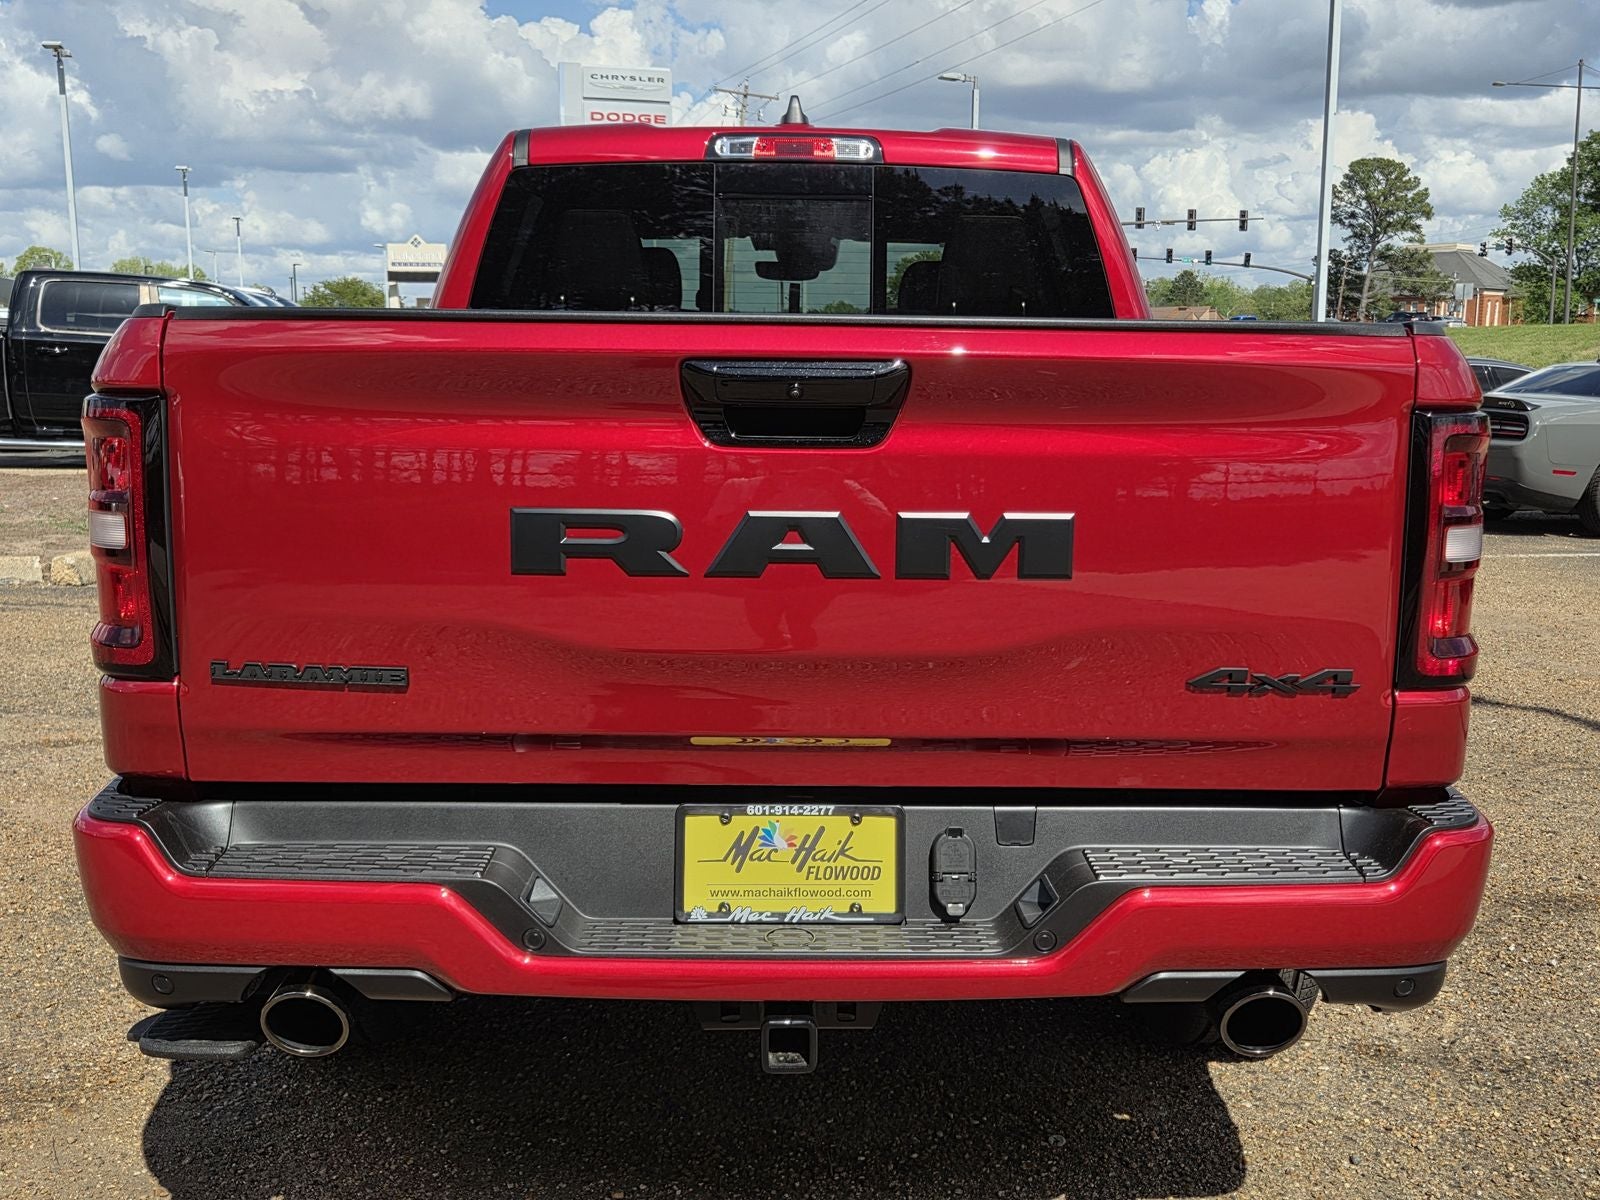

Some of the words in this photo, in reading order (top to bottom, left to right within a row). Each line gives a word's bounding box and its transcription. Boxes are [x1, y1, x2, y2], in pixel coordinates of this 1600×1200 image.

[590, 73, 665, 83] CHRYSLER
[590, 111, 666, 124] DODGE
[510, 507, 1076, 580] RAM
[210, 660, 409, 693] LARAMIE
[1185, 667, 1361, 698] 4x4
[746, 804, 835, 816] 601-914-2277
[697, 826, 789, 873] Mac
[789, 826, 883, 873] Haik
[805, 865, 882, 881] FLOWOOD
[709, 887, 872, 898] www.machaikflowood.com
[718, 906, 779, 923] Mac
[784, 906, 855, 923] Haik
